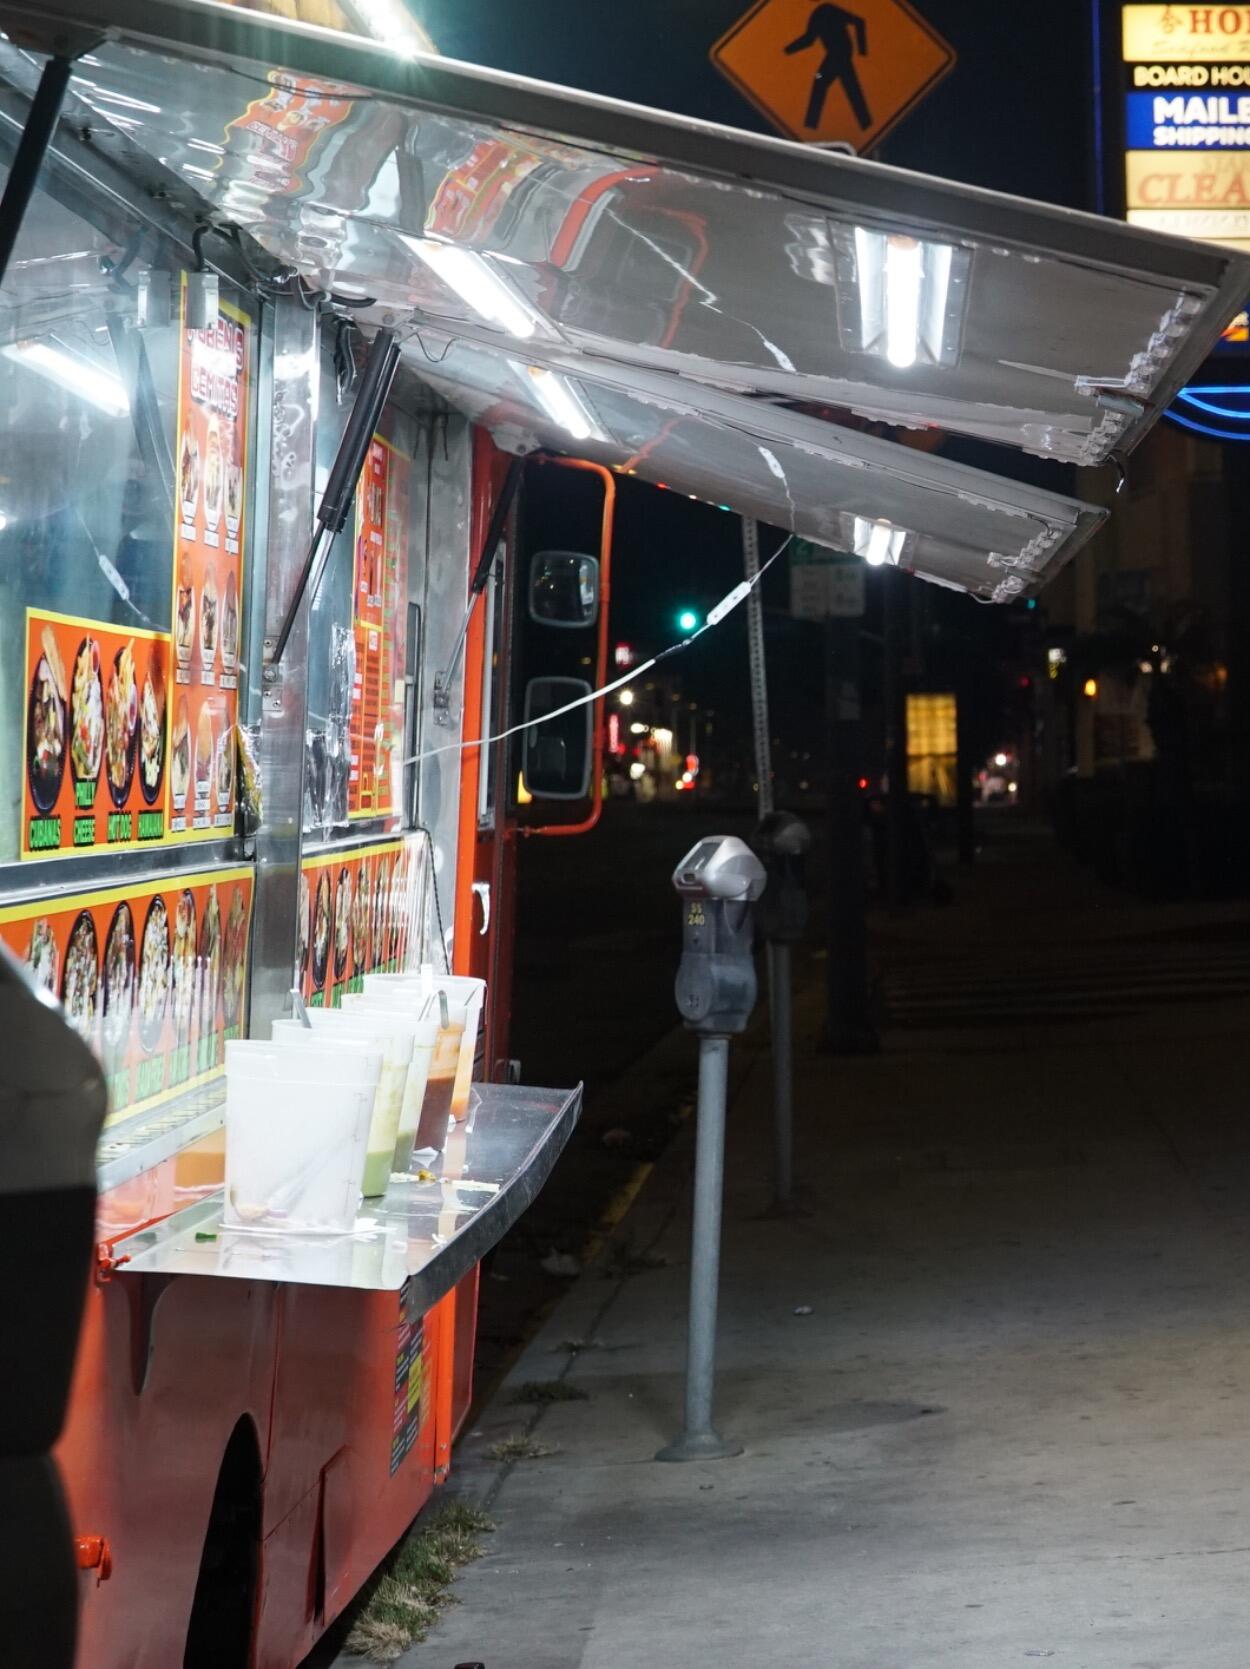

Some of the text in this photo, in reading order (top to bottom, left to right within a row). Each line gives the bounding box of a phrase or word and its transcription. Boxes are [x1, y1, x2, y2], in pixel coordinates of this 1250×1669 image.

[1134, 66, 1208, 86] BOARD
[29, 818, 61, 849] CUBANAS
[75, 819, 95, 844] CHEESE
[108, 814, 119, 841] HOT
